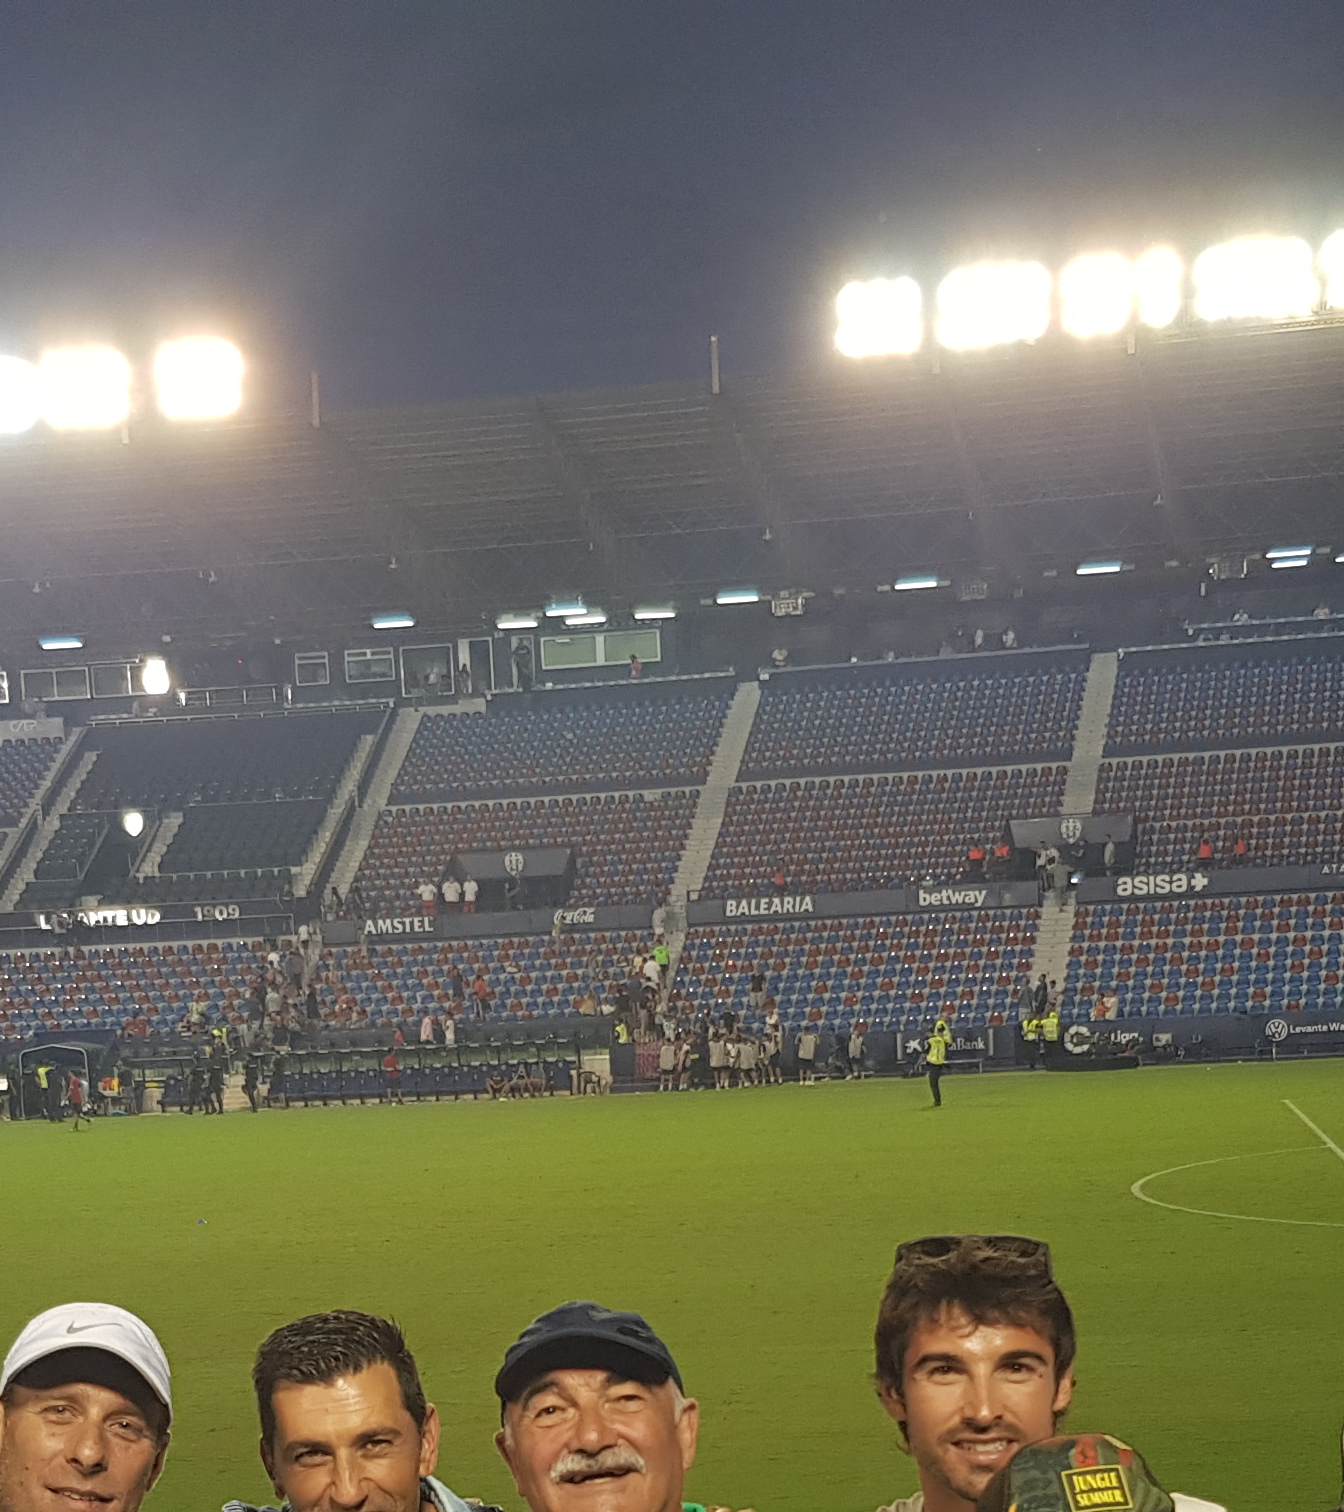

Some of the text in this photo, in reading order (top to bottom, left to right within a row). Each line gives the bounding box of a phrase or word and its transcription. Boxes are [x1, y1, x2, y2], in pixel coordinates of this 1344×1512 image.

[918, 889, 987, 908] betway
[39, 909, 128, 930] LANTE
[131, 909, 161, 926] UD
[363, 916, 434, 935] AMSTEL
[1289, 1023, 1328, 1036] Levante
[1072, 1471, 1119, 1493] JUNGLE
[1075, 1489, 1125, 1506] SUMMER
